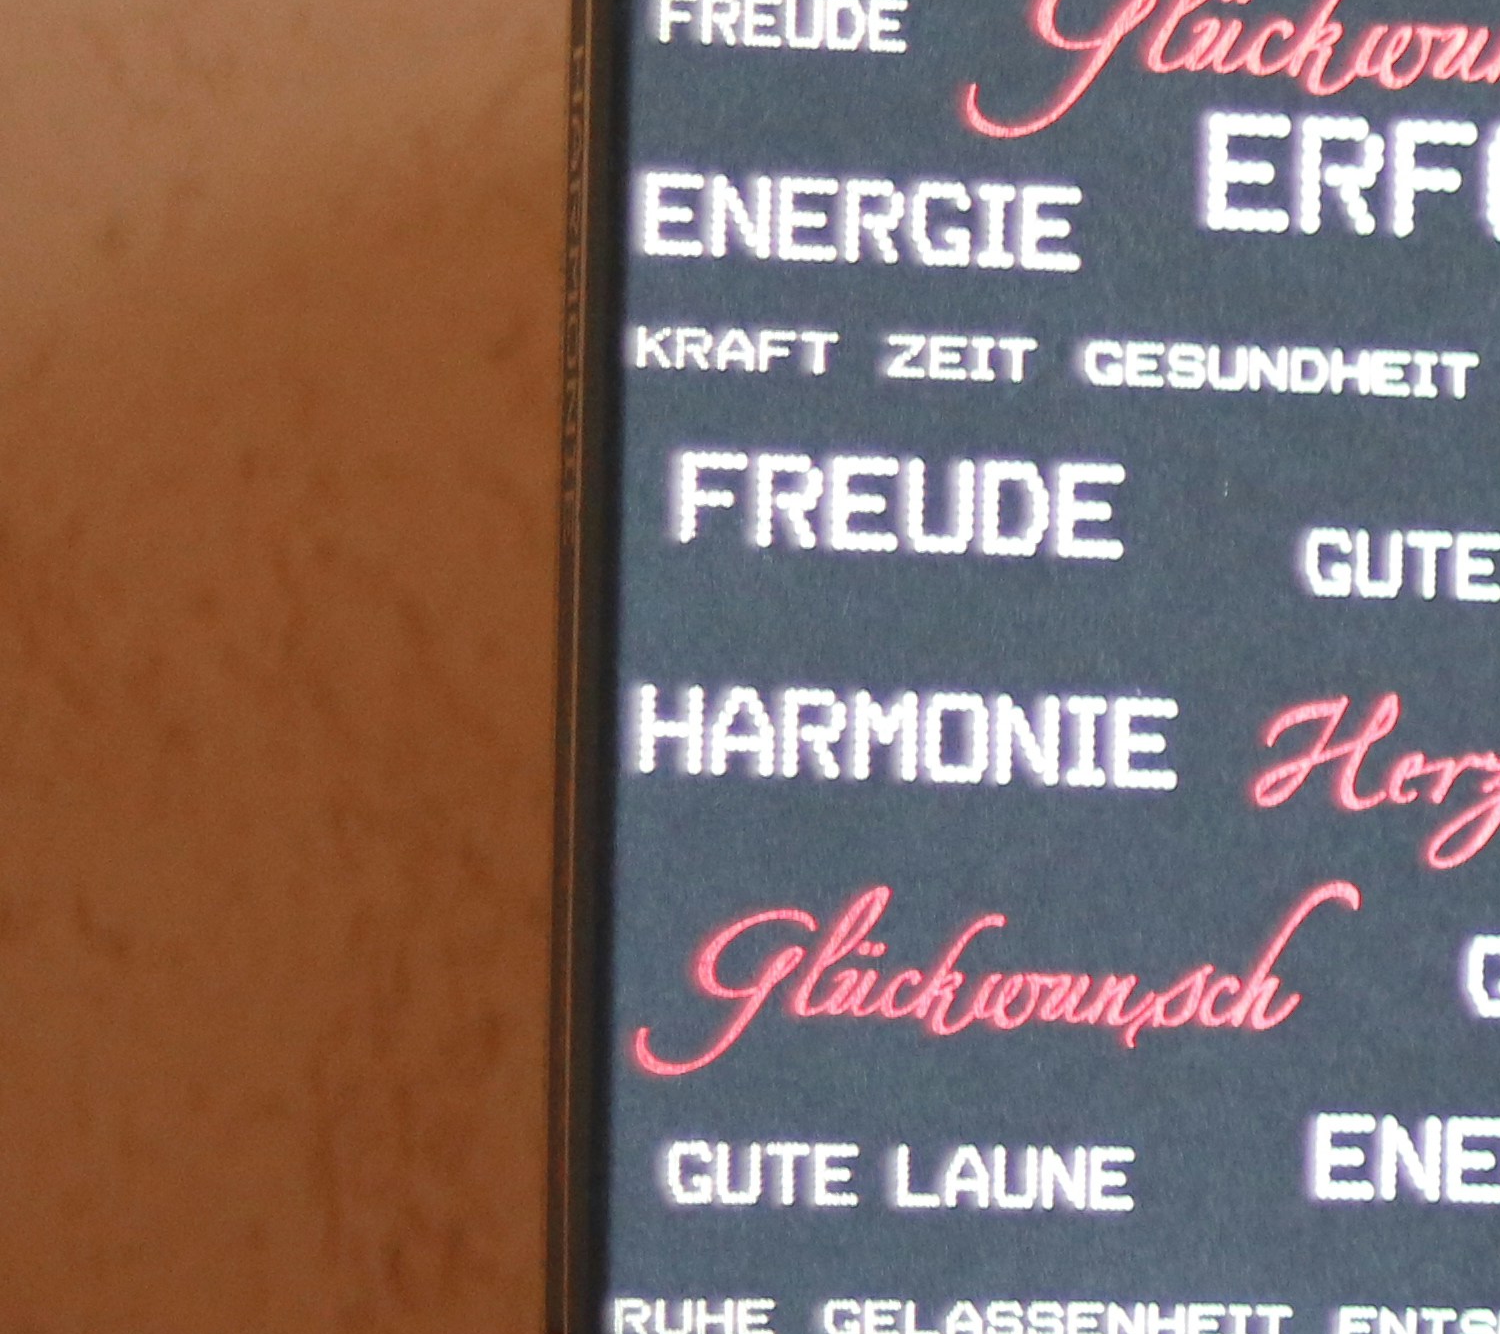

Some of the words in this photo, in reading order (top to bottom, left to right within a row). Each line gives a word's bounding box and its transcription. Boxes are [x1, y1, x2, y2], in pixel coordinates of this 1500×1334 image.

[637, 171, 1083, 272] ENERGIE
[631, 326, 839, 376] KRAFT
[883, 334, 1038, 384] ZEIT
[1078, 340, 1480, 400] GESUNDHEIT
[672, 450, 1126, 560] FREUDE
[632, 684, 1179, 791] HARMONIE
[633, 882, 1363, 1076] Glückwunsch
[664, 1139, 860, 1208] GUTE
[888, 1144, 1136, 1213] LAUNE
